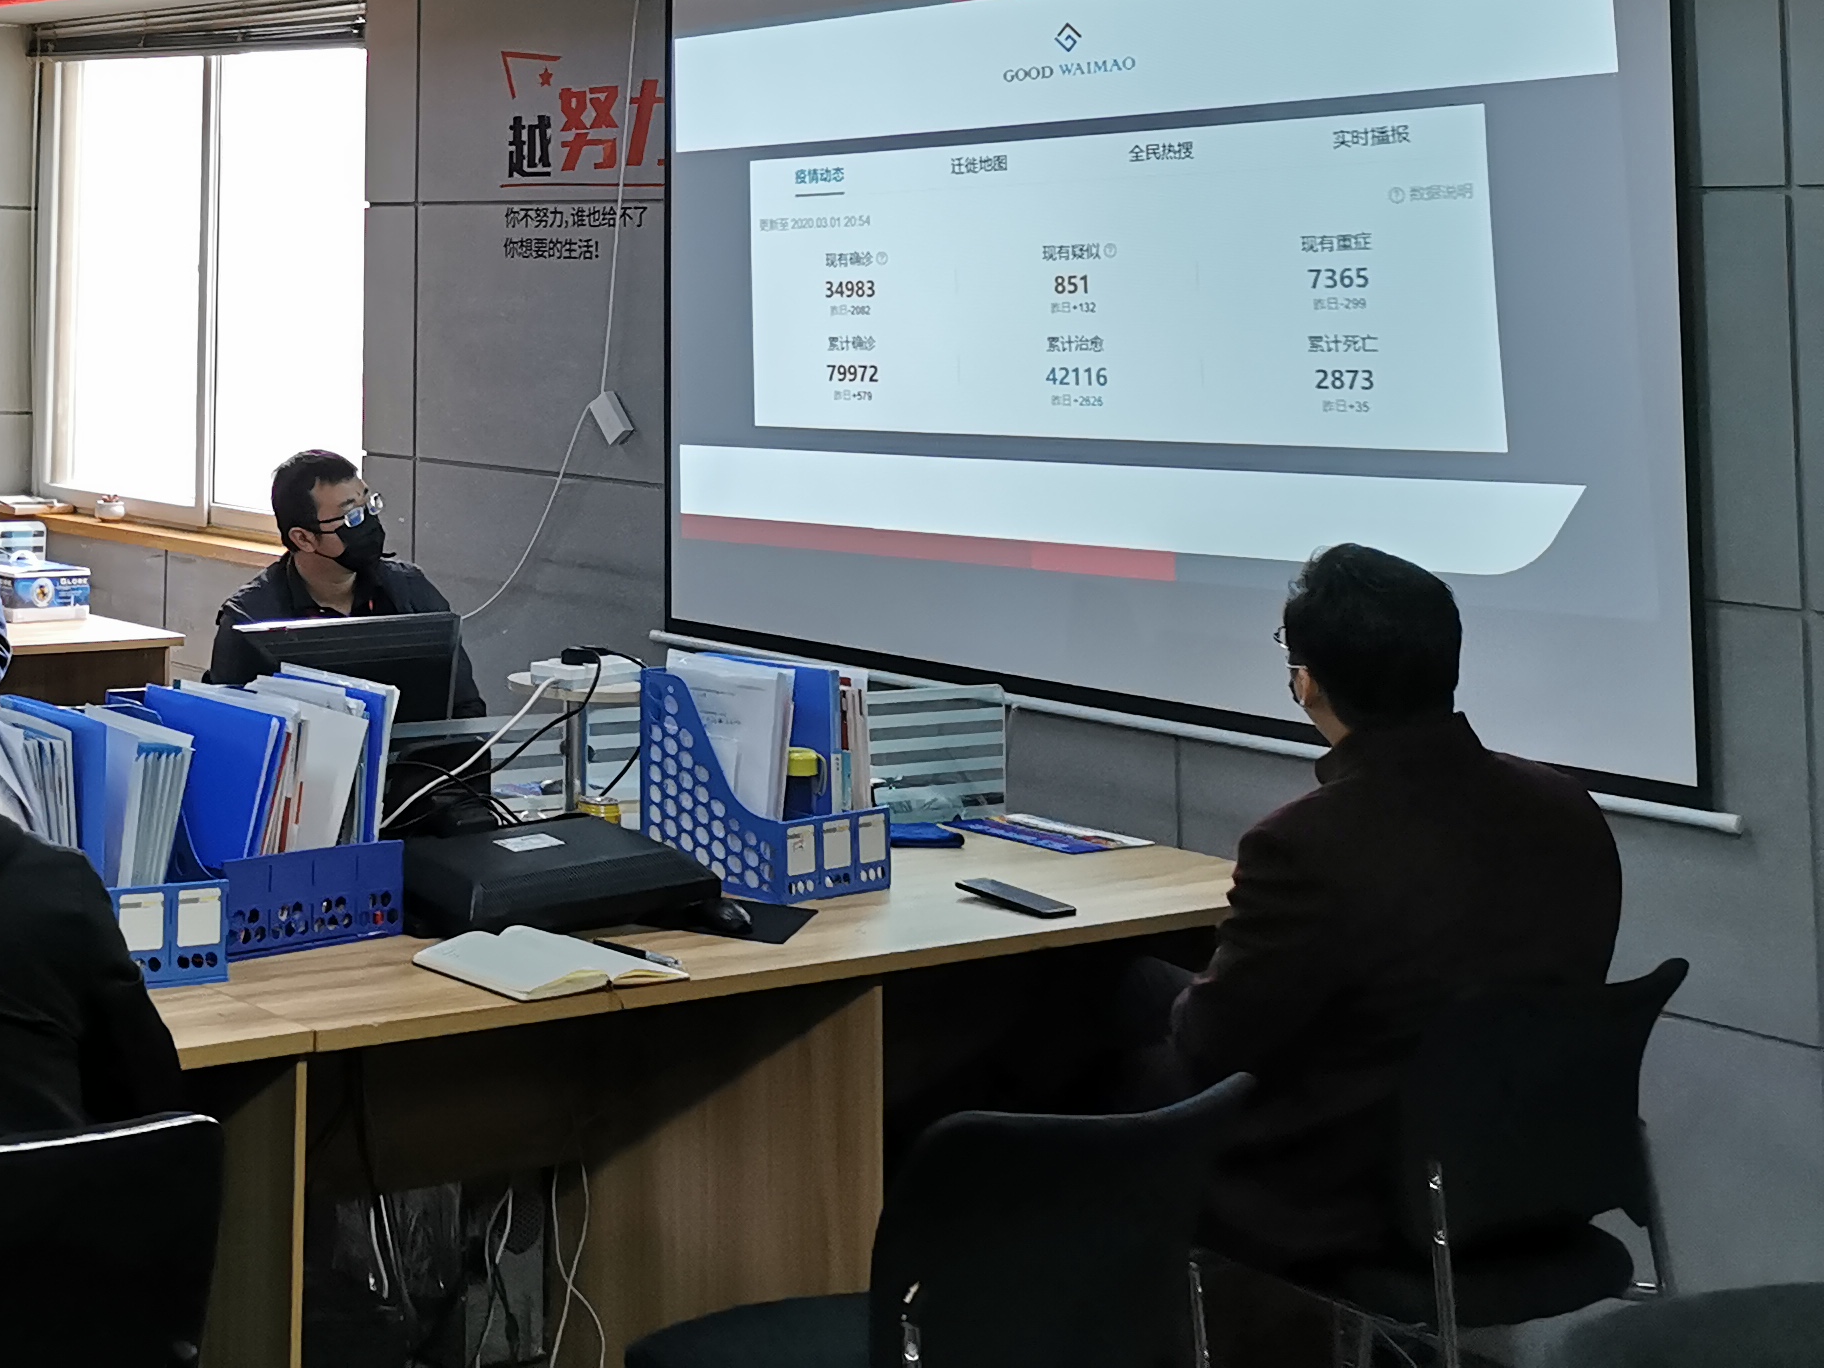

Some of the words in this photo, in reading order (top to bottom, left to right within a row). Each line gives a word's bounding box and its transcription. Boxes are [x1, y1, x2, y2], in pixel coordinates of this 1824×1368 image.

[1003, 65, 1054, 83] GOOD
[1058, 56, 1136, 76] WAIMAO
[1332, 124, 1411, 149] 实时播报
[1128, 141, 1195, 162] 全民热搜
[950, 154, 1008, 175] 迁徙地图
[794, 166, 845, 184] 疫情动态
[759, 217, 789, 232] 更新至
[1300, 232, 1373, 253] 现有重症
[825, 250, 874, 268] 现有确诊
[1042, 243, 1101, 262] 现有疑似
[1053, 273, 1090, 294] 851
[1306, 267, 1370, 289] 7365
[824, 280, 876, 299] 34983
[827, 335, 877, 351] 累计确诊
[1045, 334, 1105, 353] 累计治愈
[1307, 334, 1379, 353] 累计死亡
[826, 364, 879, 382] 79972
[1045, 367, 1108, 386] 42116
[1314, 369, 1374, 390] 2873
